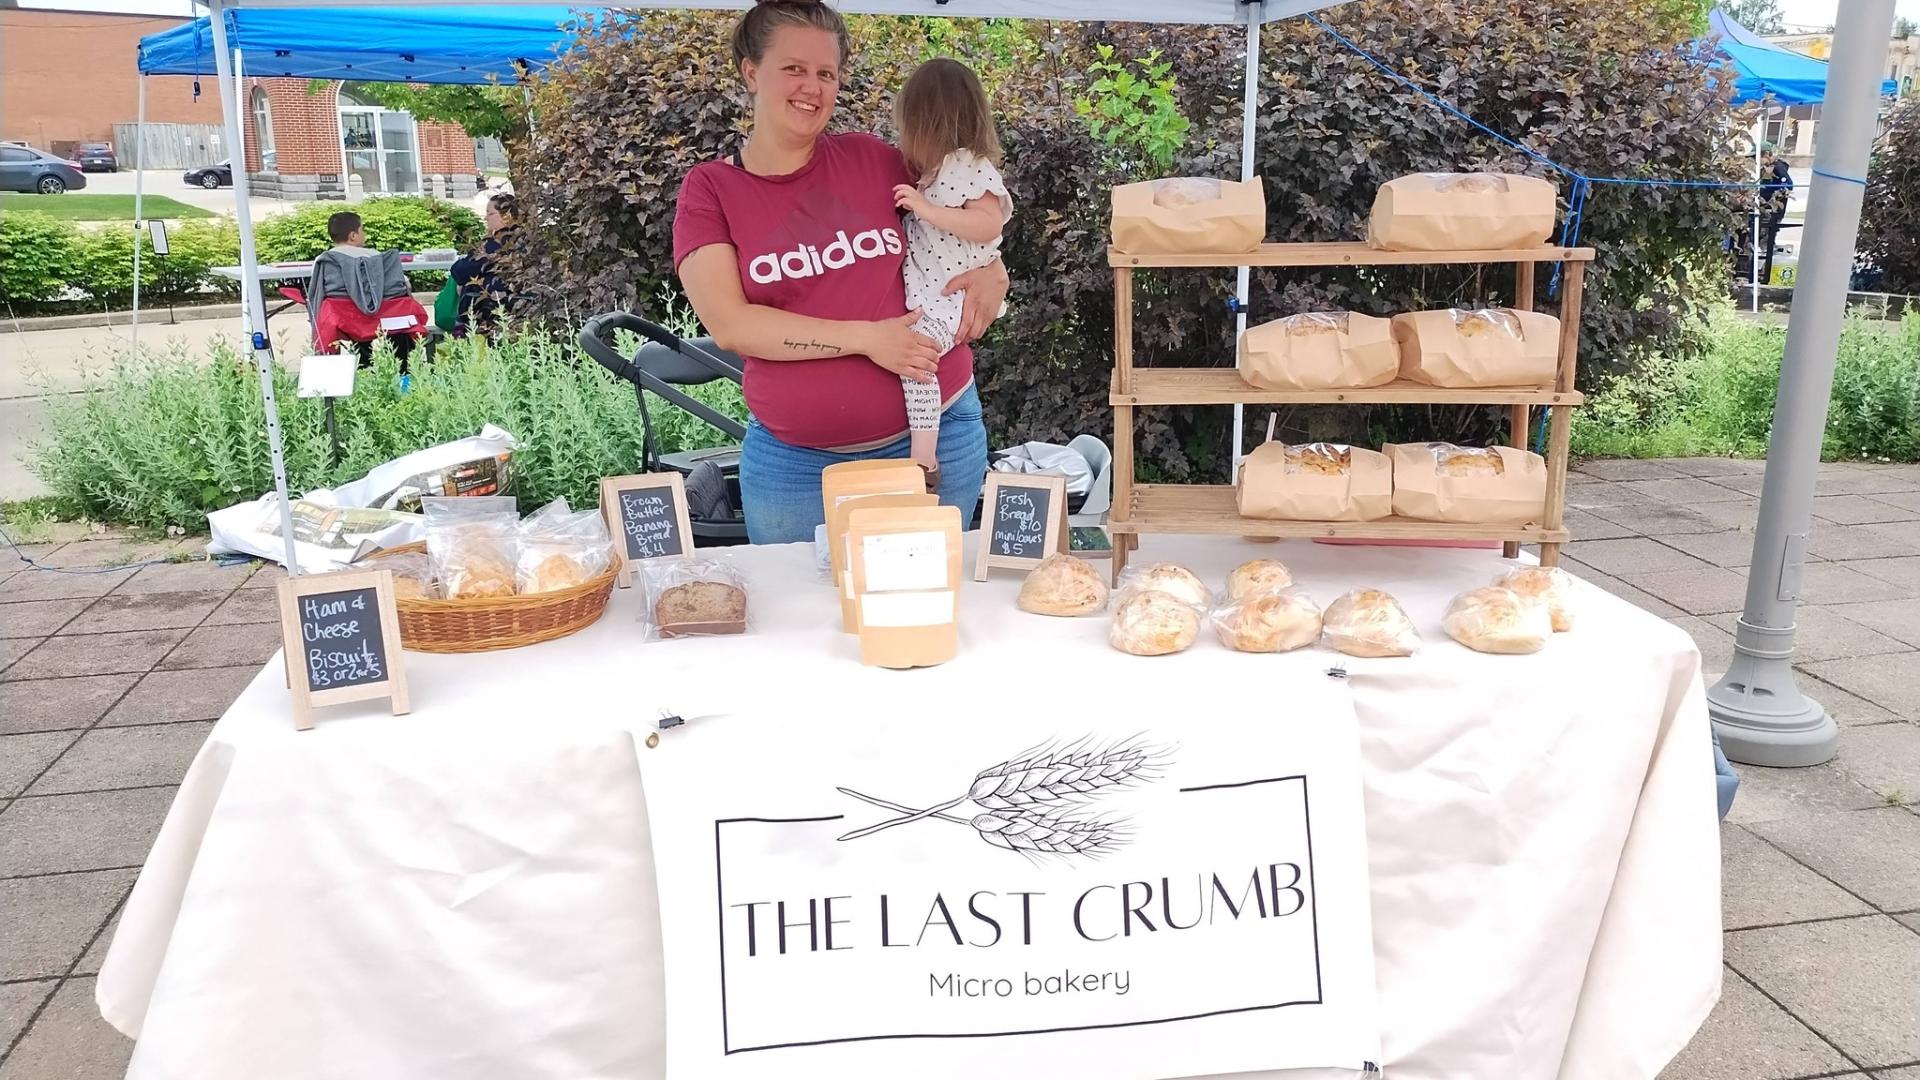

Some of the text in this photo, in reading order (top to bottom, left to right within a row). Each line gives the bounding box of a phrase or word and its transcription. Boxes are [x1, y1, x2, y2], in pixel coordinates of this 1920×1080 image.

[749, 227, 902, 284] adidas
[621, 494, 664, 508] Brown
[998, 489, 1034, 508] Fresh
[625, 504, 669, 519] Butter
[999, 503, 1036, 522] Bread
[624, 520, 673, 535] Banana
[635, 528, 671, 546] Bread
[305, 599, 347, 620] Ham
[303, 620, 360, 642] Cheese
[730, 862, 1305, 957] THE LAST CRUMB
[929, 968, 1130, 998] Micro bakery
